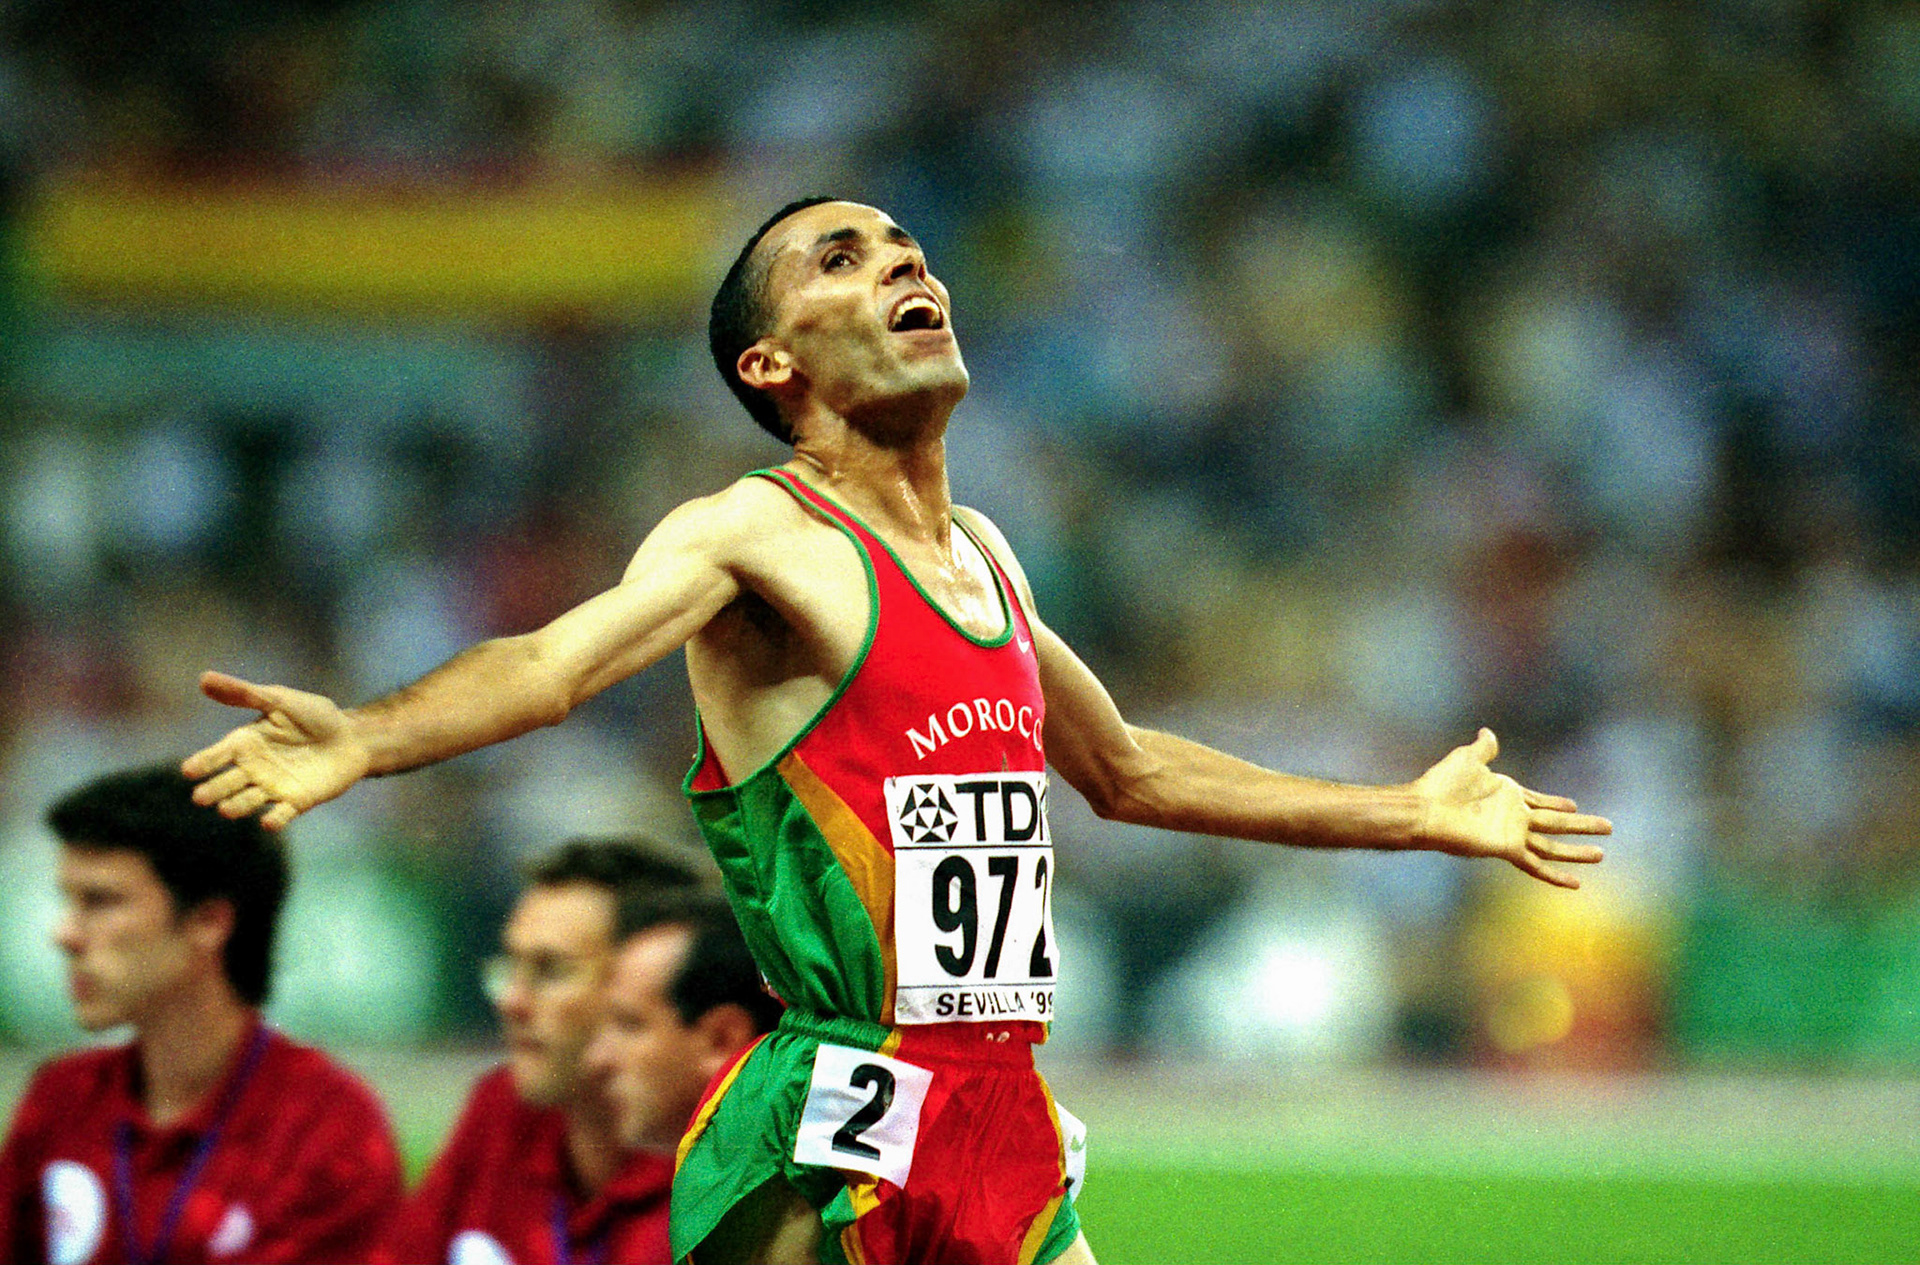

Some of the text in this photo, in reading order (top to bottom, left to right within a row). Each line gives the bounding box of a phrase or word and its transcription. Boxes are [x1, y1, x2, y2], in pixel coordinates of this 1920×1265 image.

[932, 854, 1054, 979] 972
[935, 991, 1026, 1016] SEVILLA
[831, 1063, 896, 1162] 2
